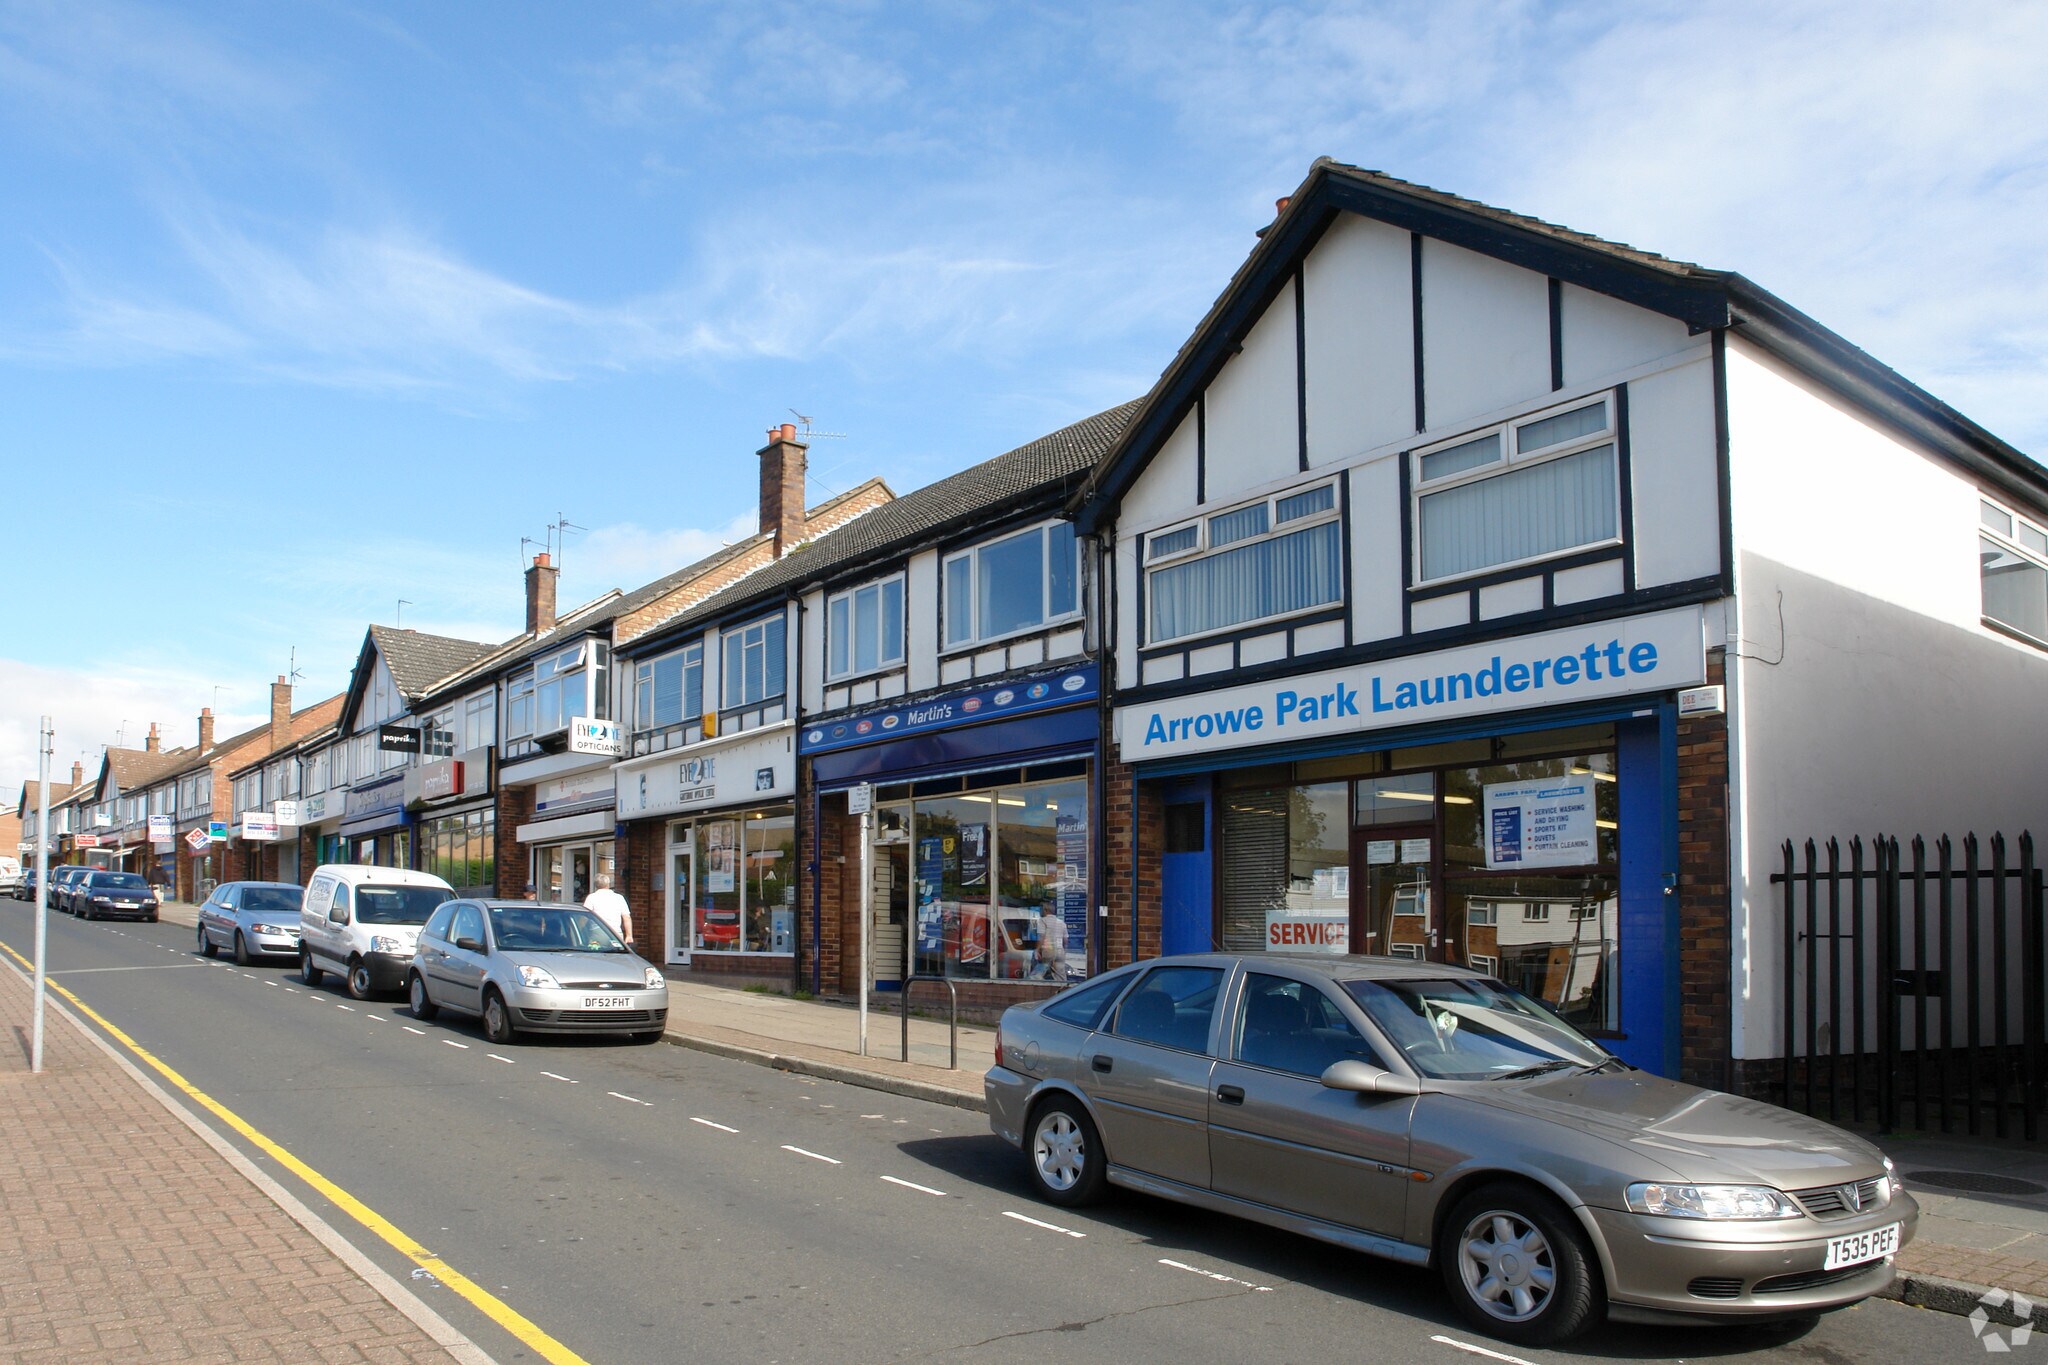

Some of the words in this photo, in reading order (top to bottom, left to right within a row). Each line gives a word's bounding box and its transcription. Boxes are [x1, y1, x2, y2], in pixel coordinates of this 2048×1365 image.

[1144, 704, 1263, 746] Arrowe
[1276, 682, 1360, 727] Park
[1372, 638, 1658, 713] Launderette
[907, 704, 952, 726] Martin's
[382, 734, 416, 744] paprika
[577, 741, 622, 753] OPTICIANS
[1534, 807, 1557, 816] SERVICE
[1560, 804, 1585, 813] WASHING
[1534, 817, 1546, 825] AND
[1548, 815, 1569, 823] DRYING
[1534, 825, 1556, 833] SPORTS
[1534, 834, 1556, 842] DUVETS
[1534, 843, 1558, 851] CURTAIN
[1560, 840, 1588, 849] CLEANING
[1269, 922, 1345, 945] SERVICE
[585, 998, 610, 1007] DF52
[612, 998, 630, 1007] FHT
[1832, 1235, 1868, 1263] T535
[1872, 1227, 1895, 1254] PEF
